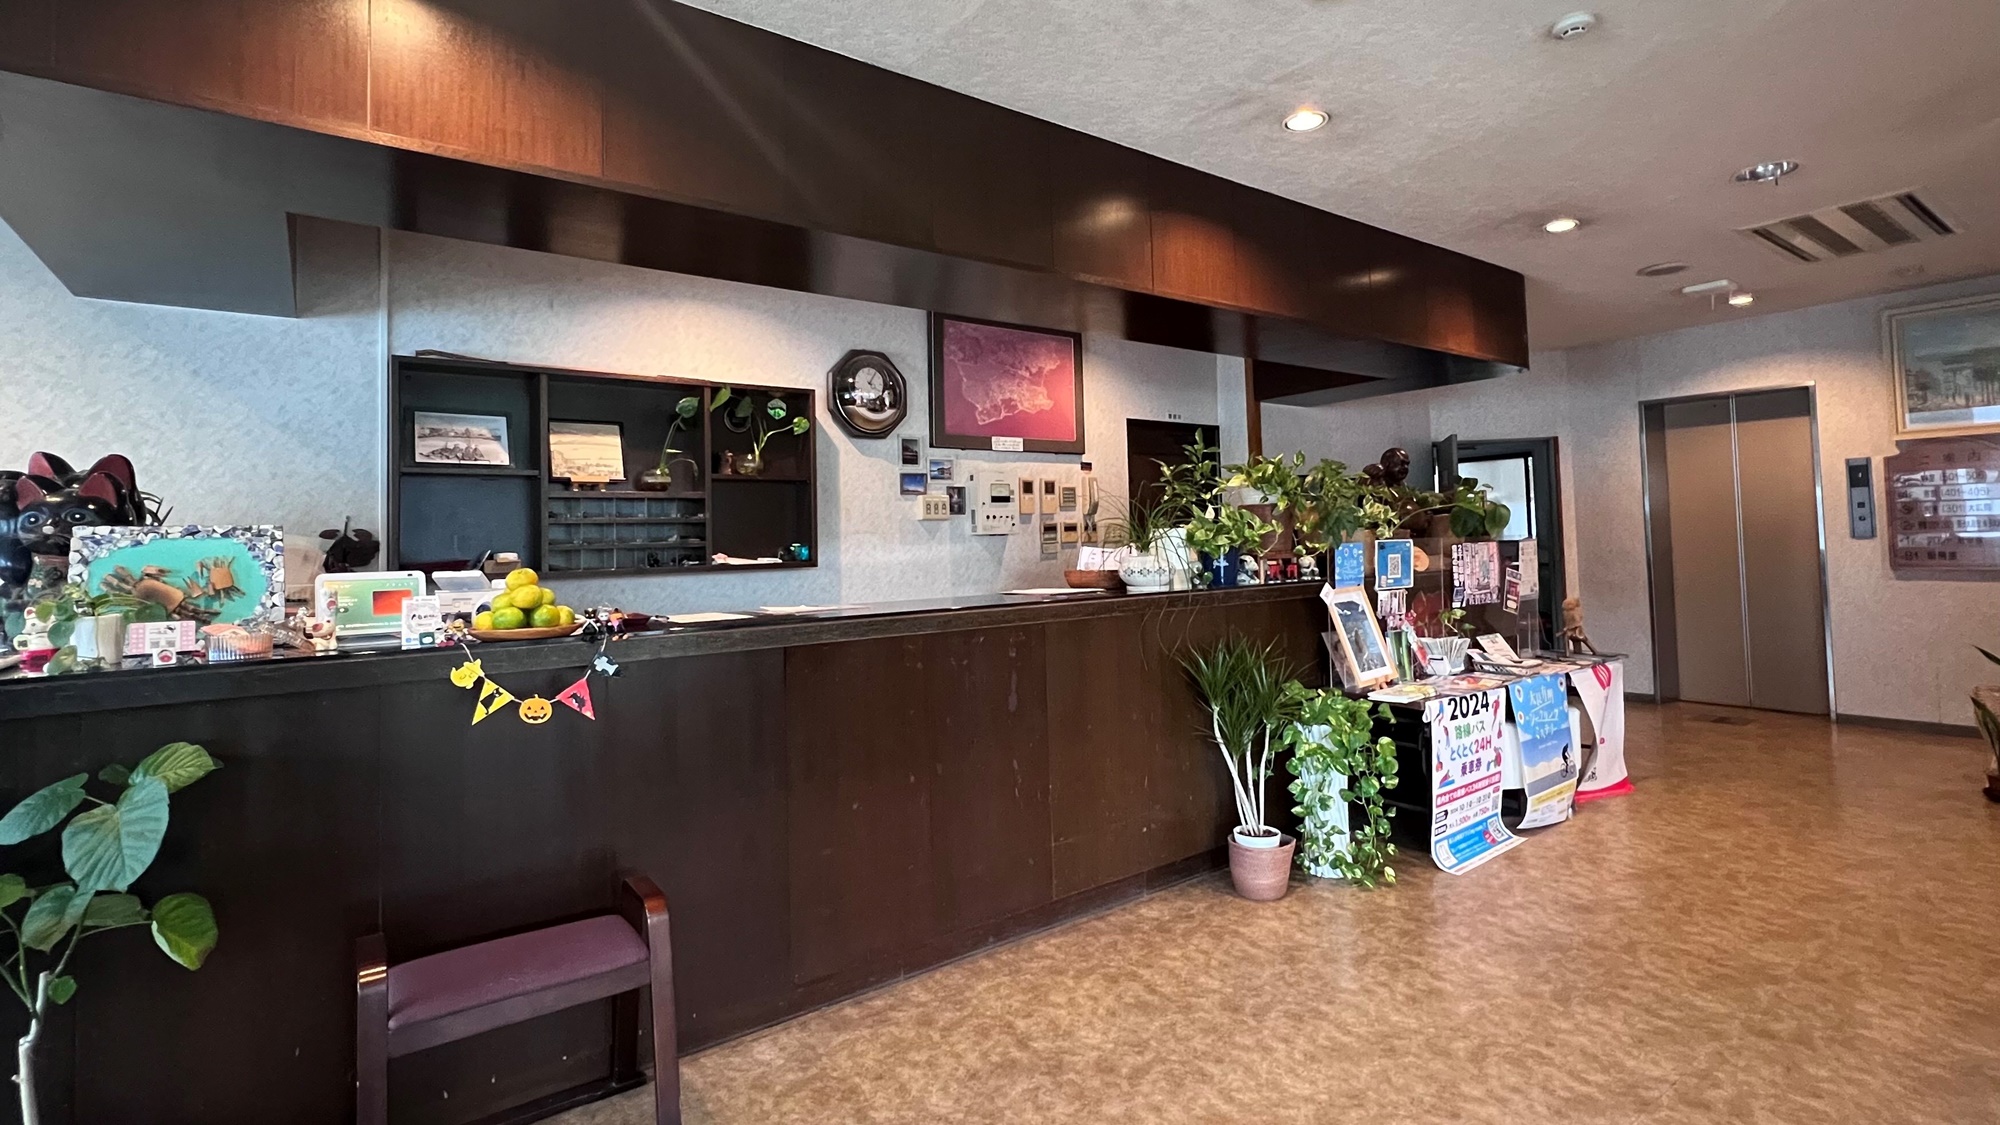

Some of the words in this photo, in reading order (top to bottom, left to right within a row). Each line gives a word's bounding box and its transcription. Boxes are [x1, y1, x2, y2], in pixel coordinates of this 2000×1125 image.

[1447, 691, 1490, 721] 2024
[1455, 720, 1486, 740] 路線バス
